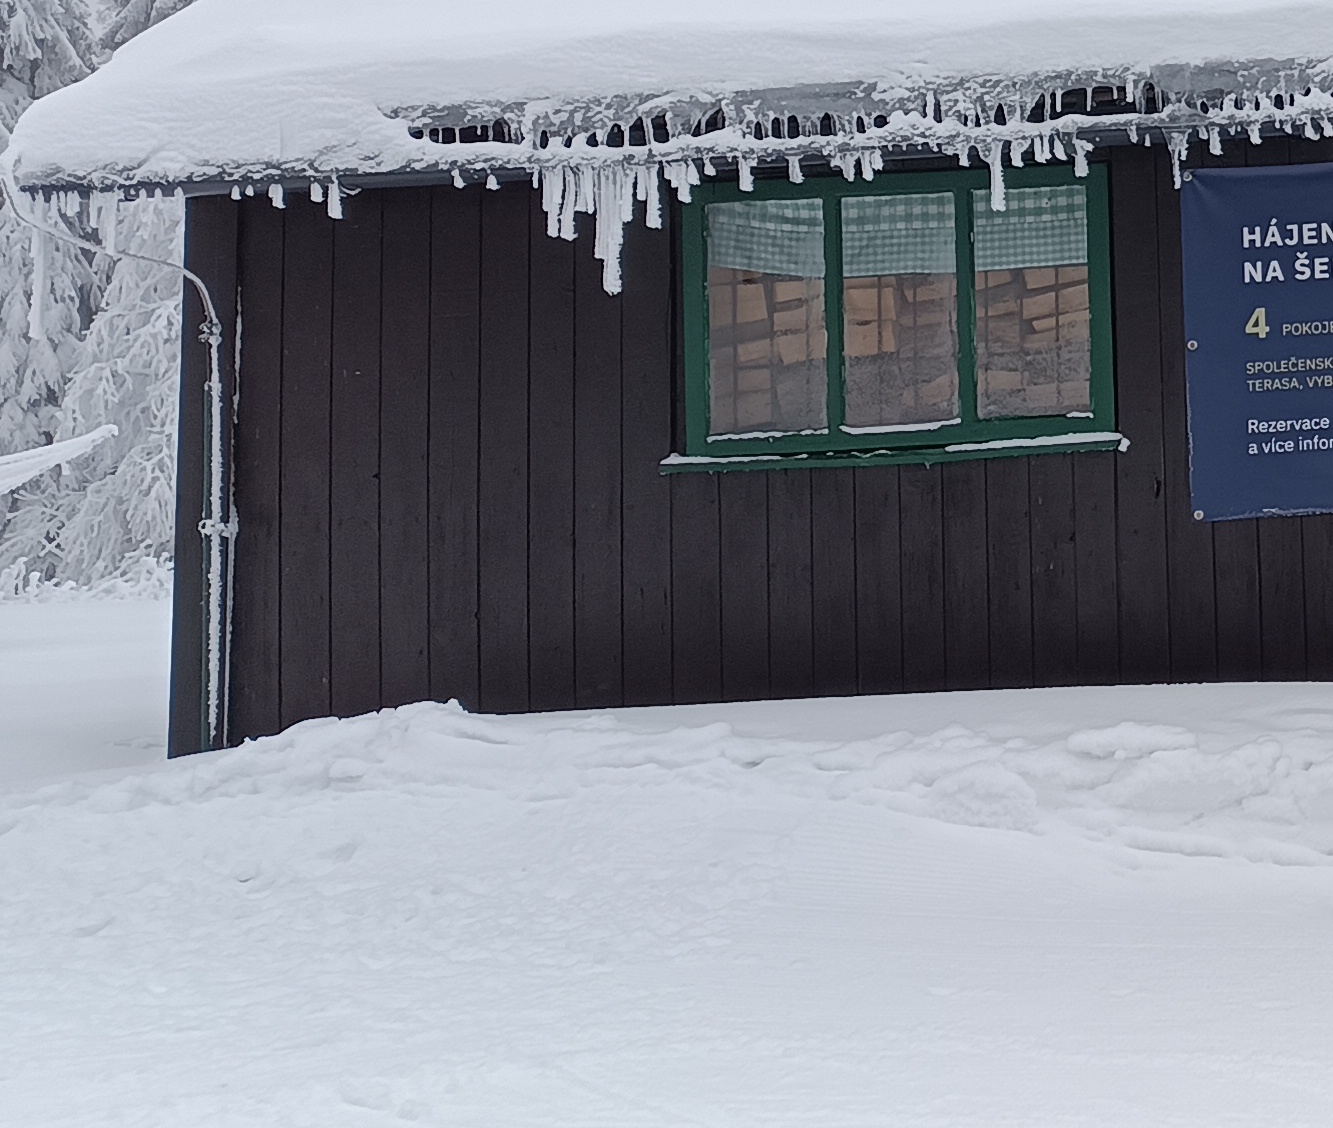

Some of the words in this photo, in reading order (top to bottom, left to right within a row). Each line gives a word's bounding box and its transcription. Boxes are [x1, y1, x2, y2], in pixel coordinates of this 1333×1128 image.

[1243, 260, 1285, 283] NA
[1245, 307, 1270, 339] 4
[1247, 377, 1304, 392] TERASA,
[1248, 417, 1331, 434] Rezervace
[1248, 443, 1259, 455] a
[1262, 437, 1294, 453] více
